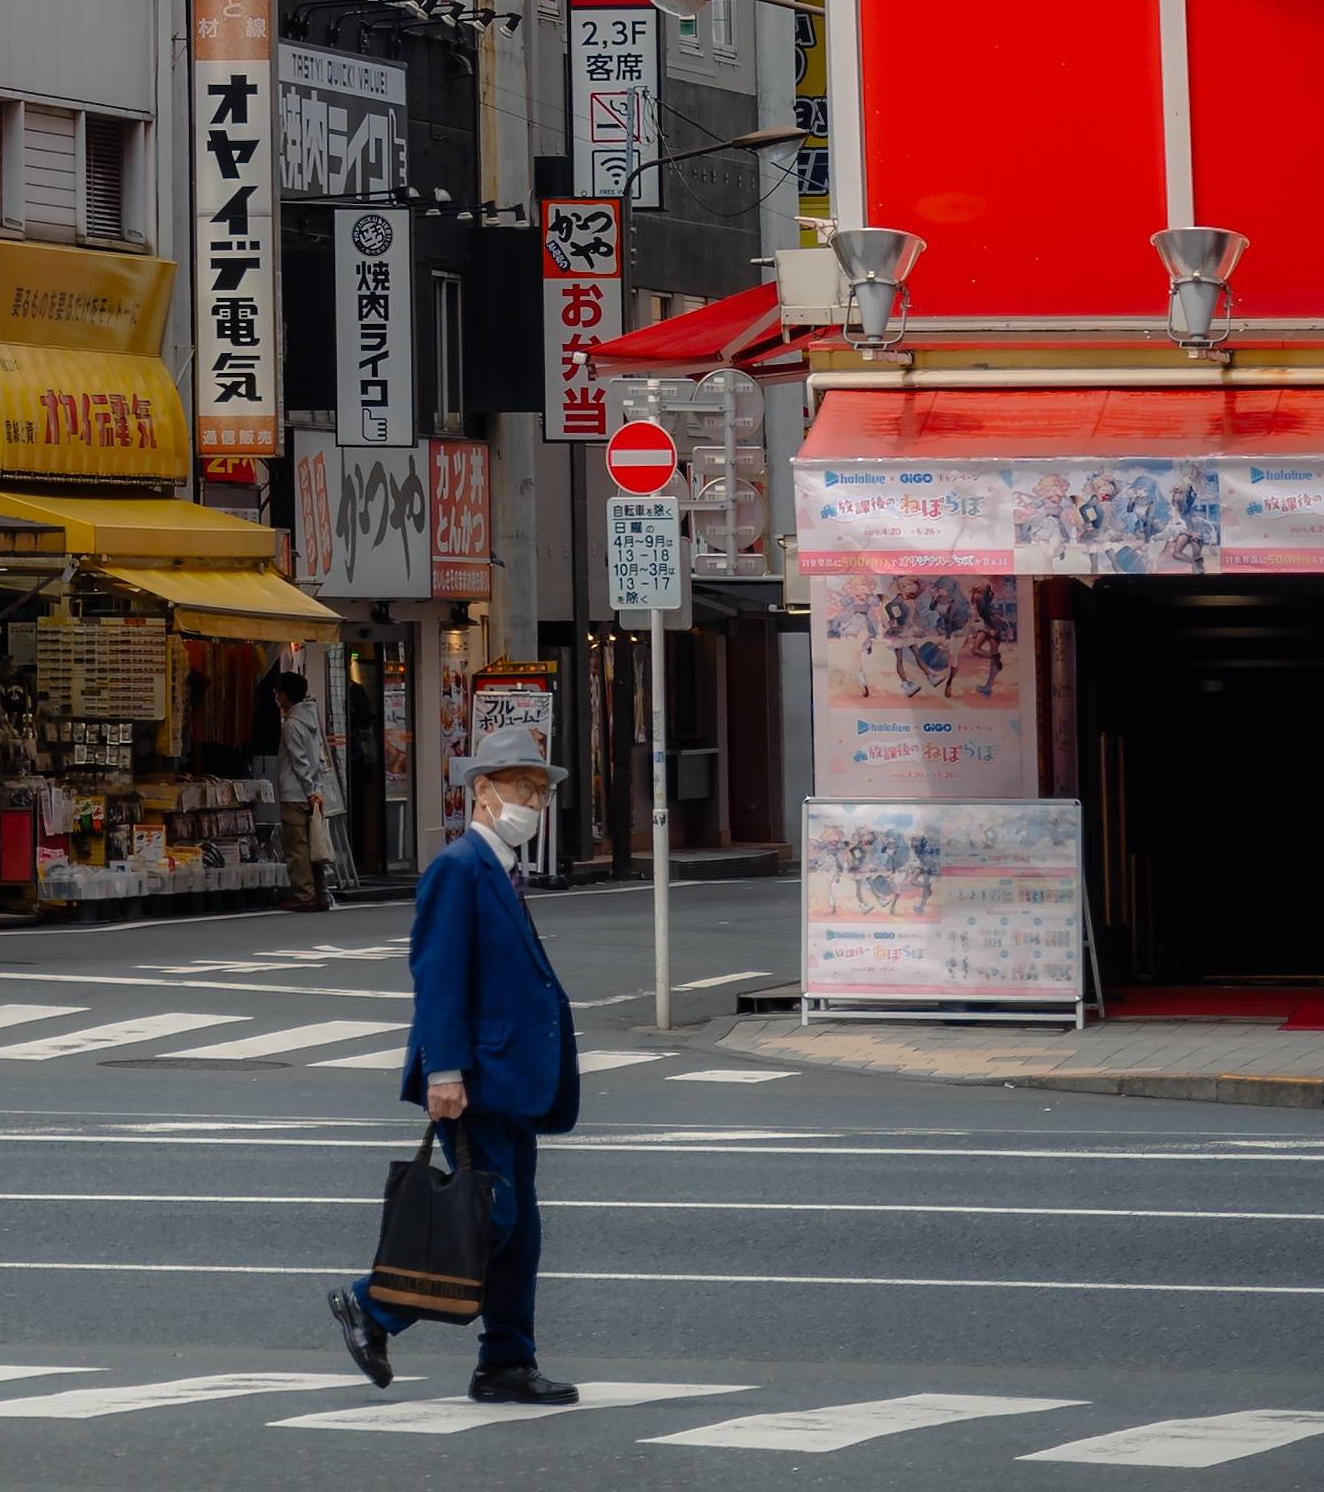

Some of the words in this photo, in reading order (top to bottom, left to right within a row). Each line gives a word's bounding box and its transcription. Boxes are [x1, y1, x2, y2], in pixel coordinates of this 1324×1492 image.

[582, 21, 647, 49] 2,3F
[293, 54, 323, 81] TASTY!
[328, 61, 354, 89] QUICK!
[359, 68, 388, 95] VALUE!
[586, 55, 644, 82] 客席
[279, 84, 390, 201] 焼肉ライク
[206, 73, 262, 405] オヤイデ電気
[356, 261, 390, 407] 焼肉ライク
[561, 284, 616, 436] お弁当
[202, 429, 273, 446] 通信販売
[840, 473, 885, 484] hololive
[900, 473, 933, 484] GiGO
[1266, 470, 1312, 481] hololive
[336, 453, 426, 585] かつや
[614, 504, 672, 517] 自転車を除く
[617, 592, 648, 605] を除く
[484, 699, 515, 715] フル
[923, 723, 953, 733] GiGO
